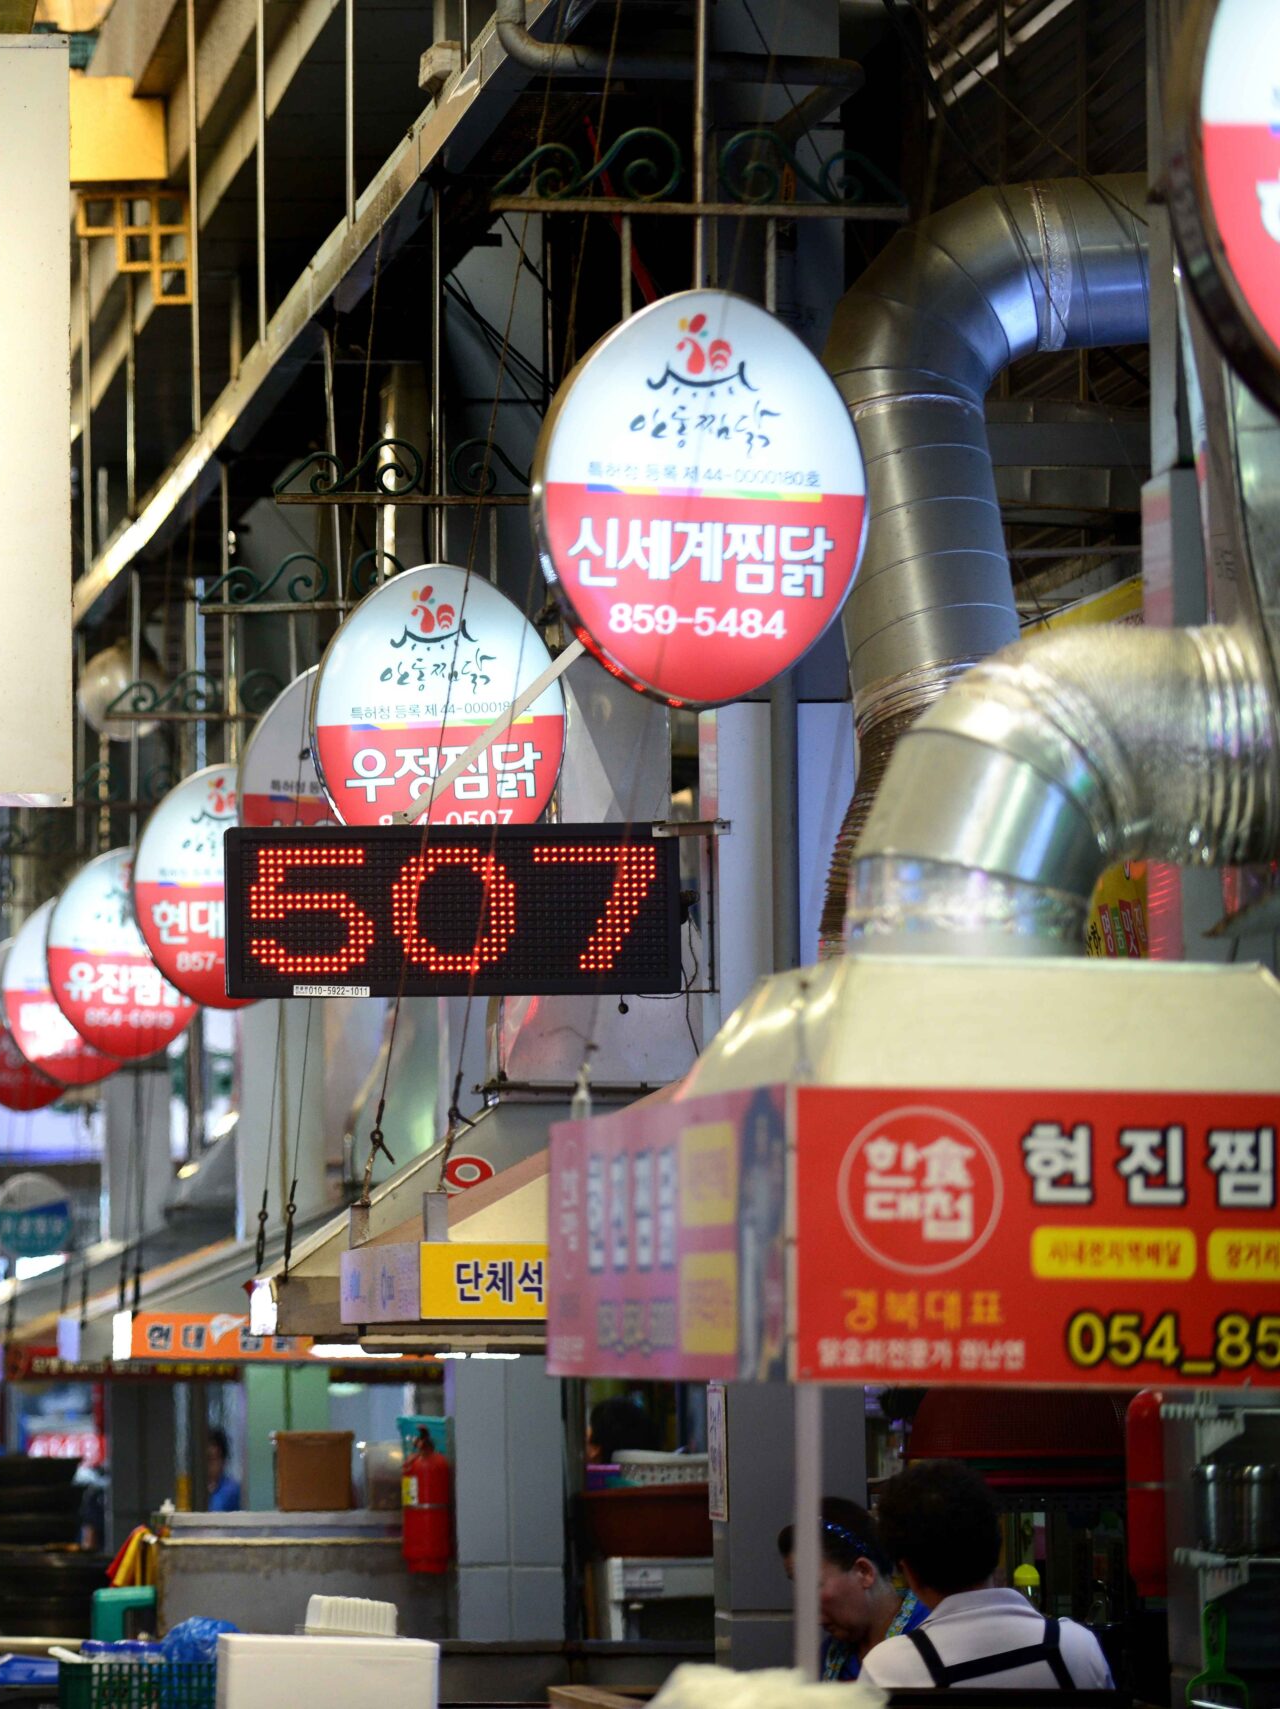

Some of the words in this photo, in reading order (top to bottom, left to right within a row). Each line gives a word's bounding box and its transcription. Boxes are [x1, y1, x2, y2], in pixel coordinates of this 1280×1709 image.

[567, 515, 834, 598] 신세계찜닭
[608, 601, 787, 640] 859-5484
[349, 705, 391, 721] 특허청
[395, 703, 421, 718] 등록
[424, 702, 438, 717] 제
[440, 701, 533, 715] 44-000018
[345, 740, 543, 804] 우정찜닭
[378, 809, 514, 826] 84-0507
[456, 1260, 544, 1303] 단체석
[842, 1289, 1005, 1334] 경북대표
